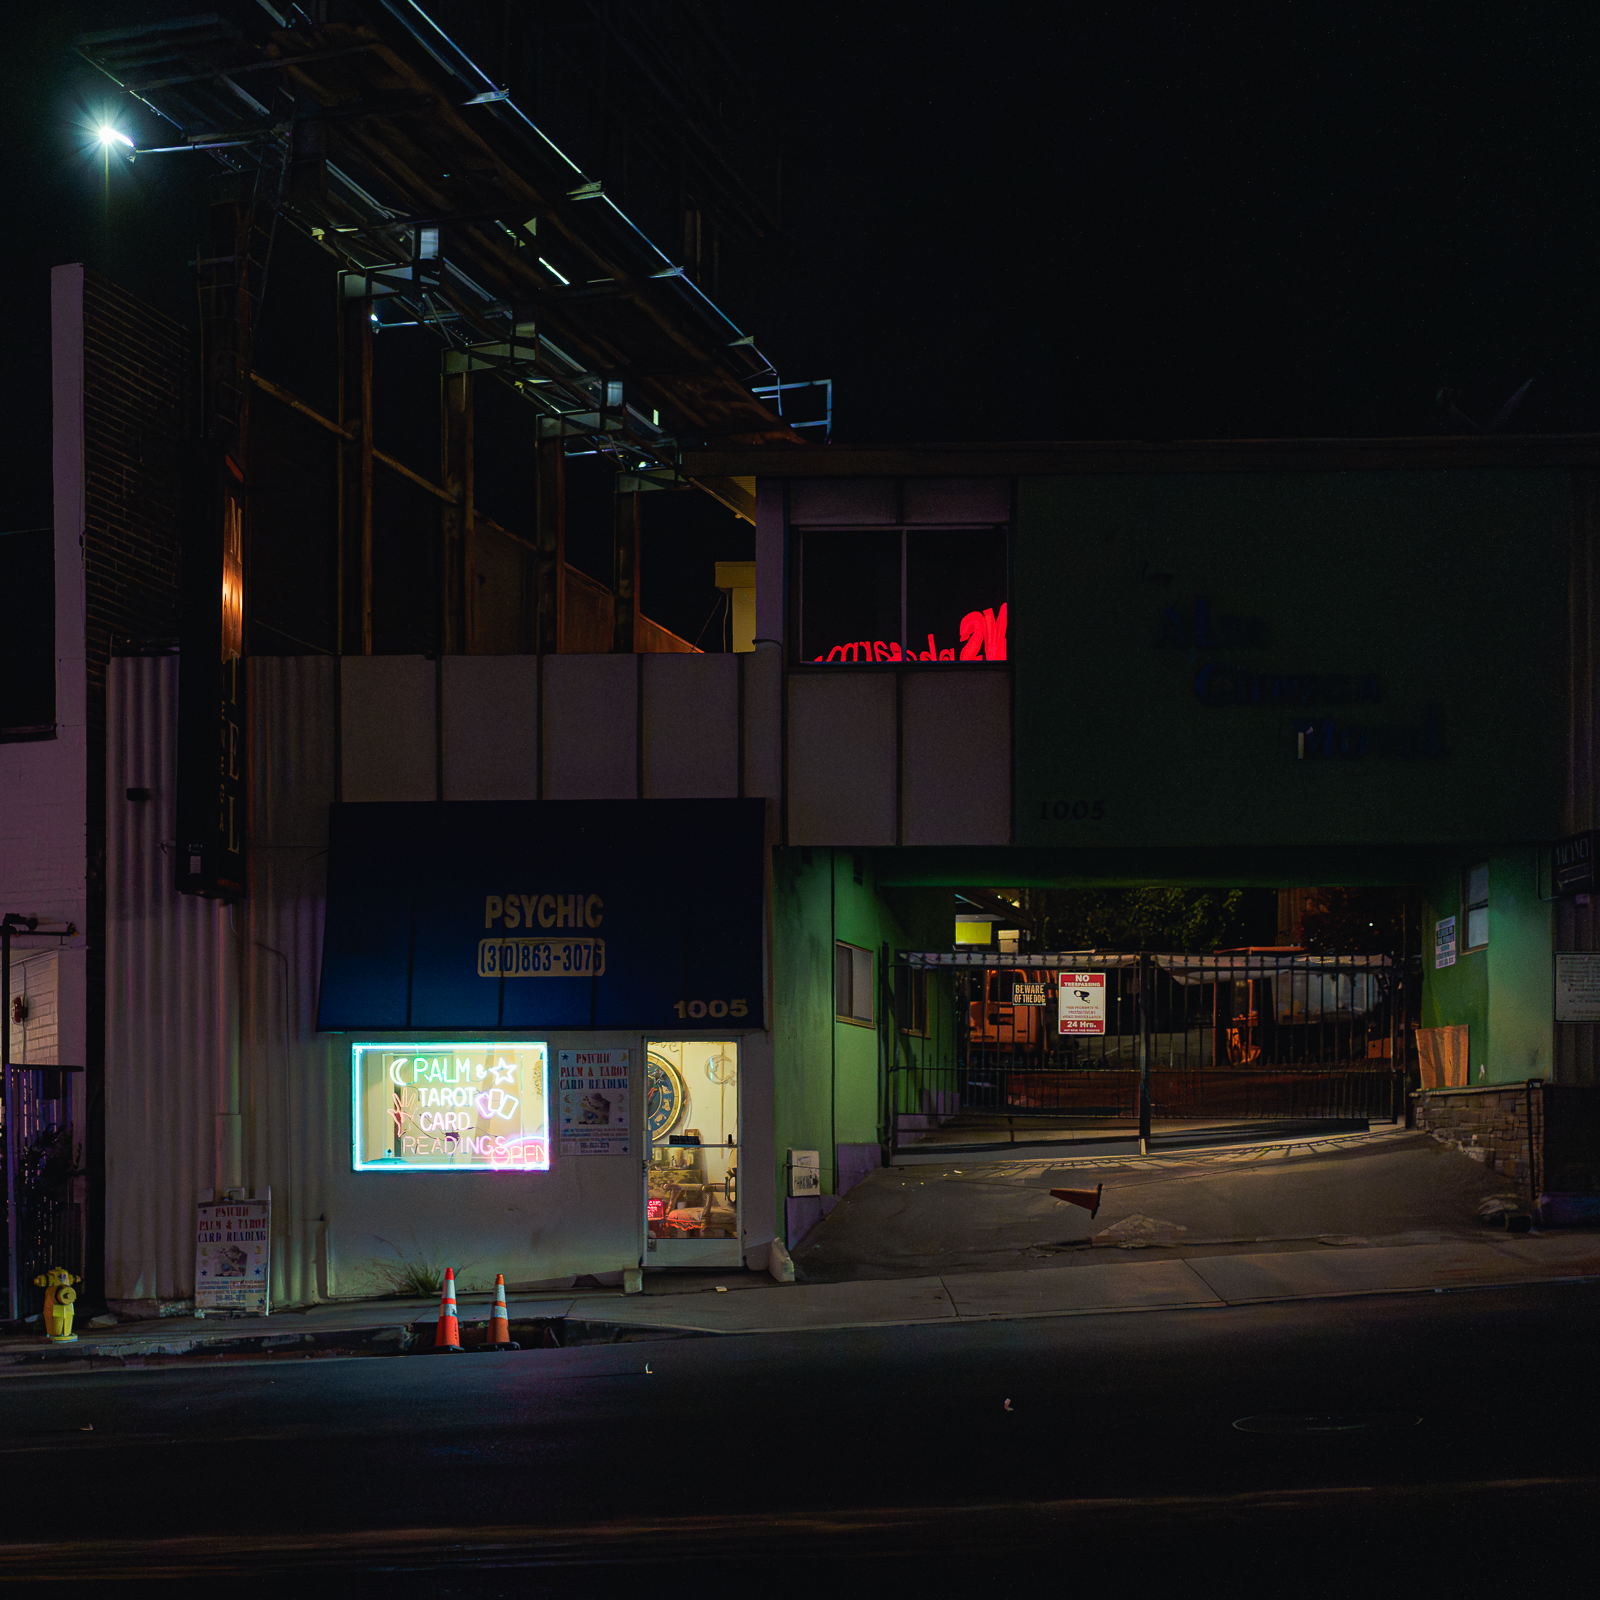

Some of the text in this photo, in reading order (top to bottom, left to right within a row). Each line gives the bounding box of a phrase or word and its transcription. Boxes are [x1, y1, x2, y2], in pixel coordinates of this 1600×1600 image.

[1037, 800, 1106, 820] 1005
[485, 894, 604, 928] PSYCHIC
[1075, 974, 1090, 982] NO
[1015, 984, 1045, 994] BEWARE
[1014, 994, 1046, 1003] OF THE DOG
[673, 999, 749, 1018] 1005
[576, 1053, 612, 1064] PSYCHIC
[413, 1057, 488, 1083] PALM &
[560, 1066, 628, 1077] PALM & TAROT
[560, 1078, 628, 1090] CARD READING
[418, 1087, 477, 1107] TAROT
[420, 1112, 471, 1131] CARD
[402, 1136, 507, 1155] READINGS
[491, 1144, 546, 1166] OPEN
[215, 1206, 249, 1218] PSYCHIC
[199, 1218, 266, 1231] PALM & TAROT
[198, 1230, 266, 1243] CARD READING
